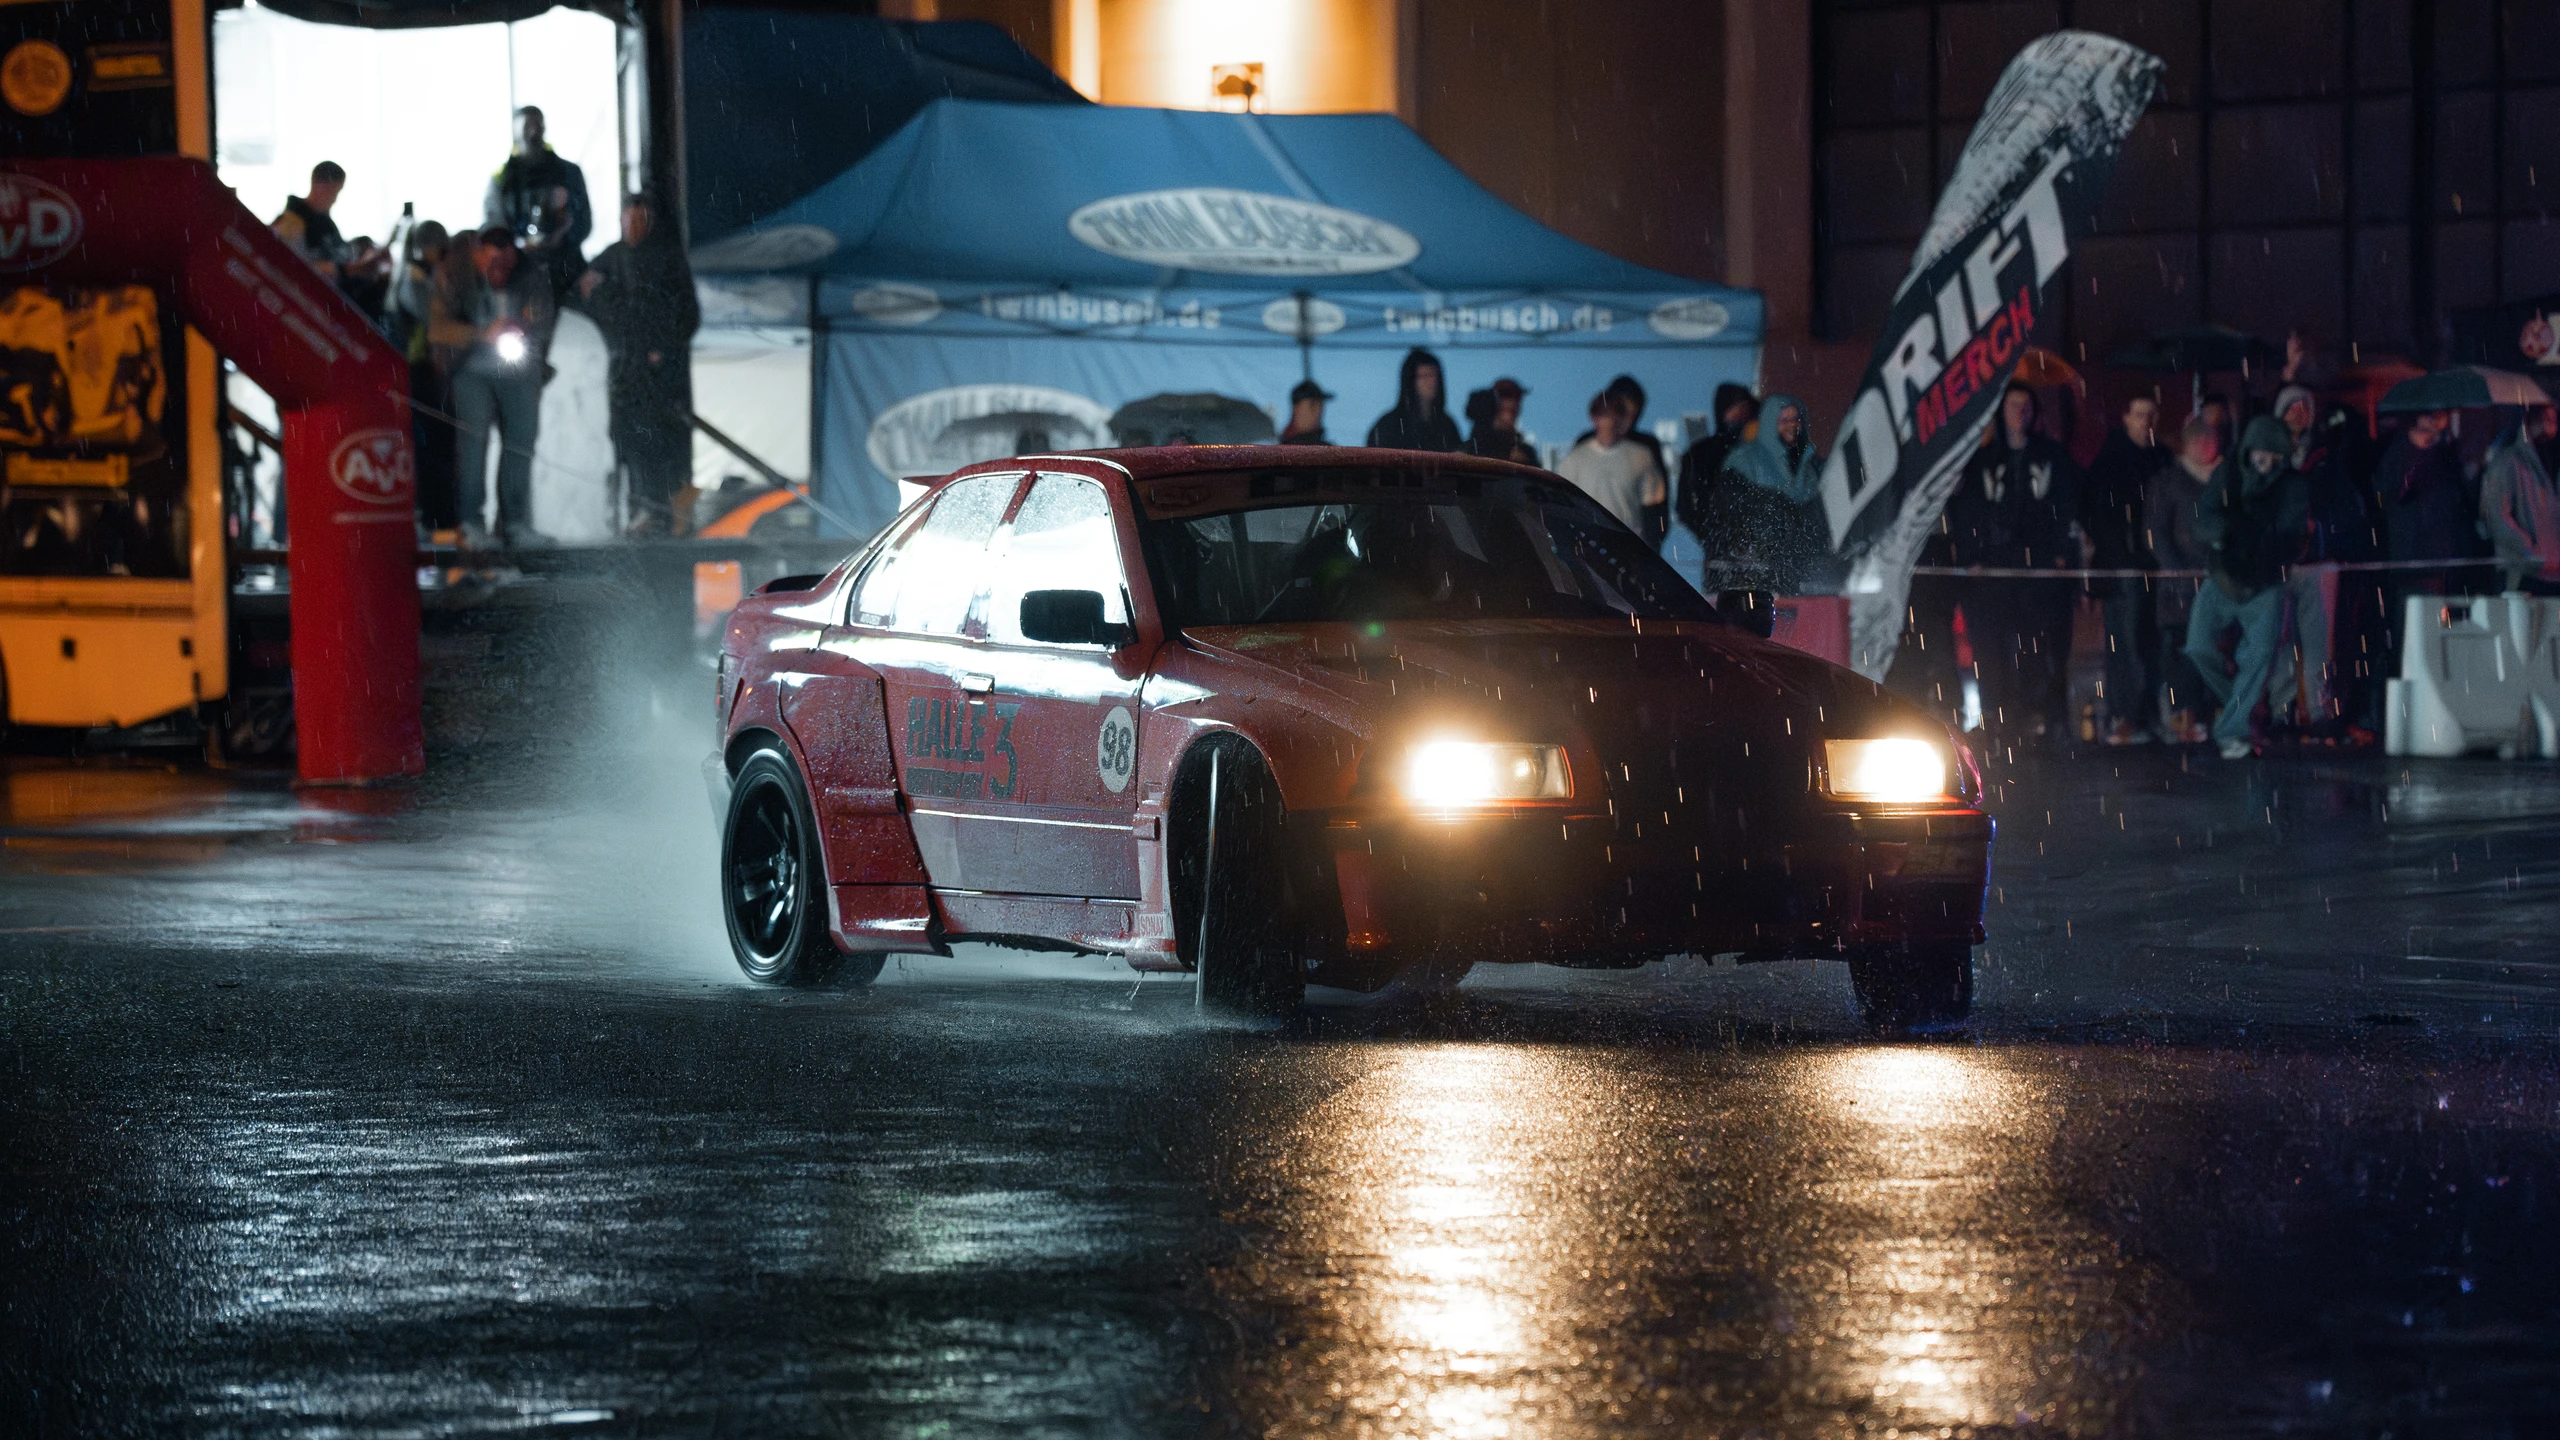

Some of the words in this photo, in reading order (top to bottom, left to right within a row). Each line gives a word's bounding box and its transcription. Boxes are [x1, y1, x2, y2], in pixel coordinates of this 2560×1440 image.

[1818, 144, 2070, 551] DRIFT
[1916, 284, 2035, 445] MERCH
[906, 696, 988, 763] HALLE
[990, 702, 1023, 800] 3
[1101, 720, 1132, 776] 98
